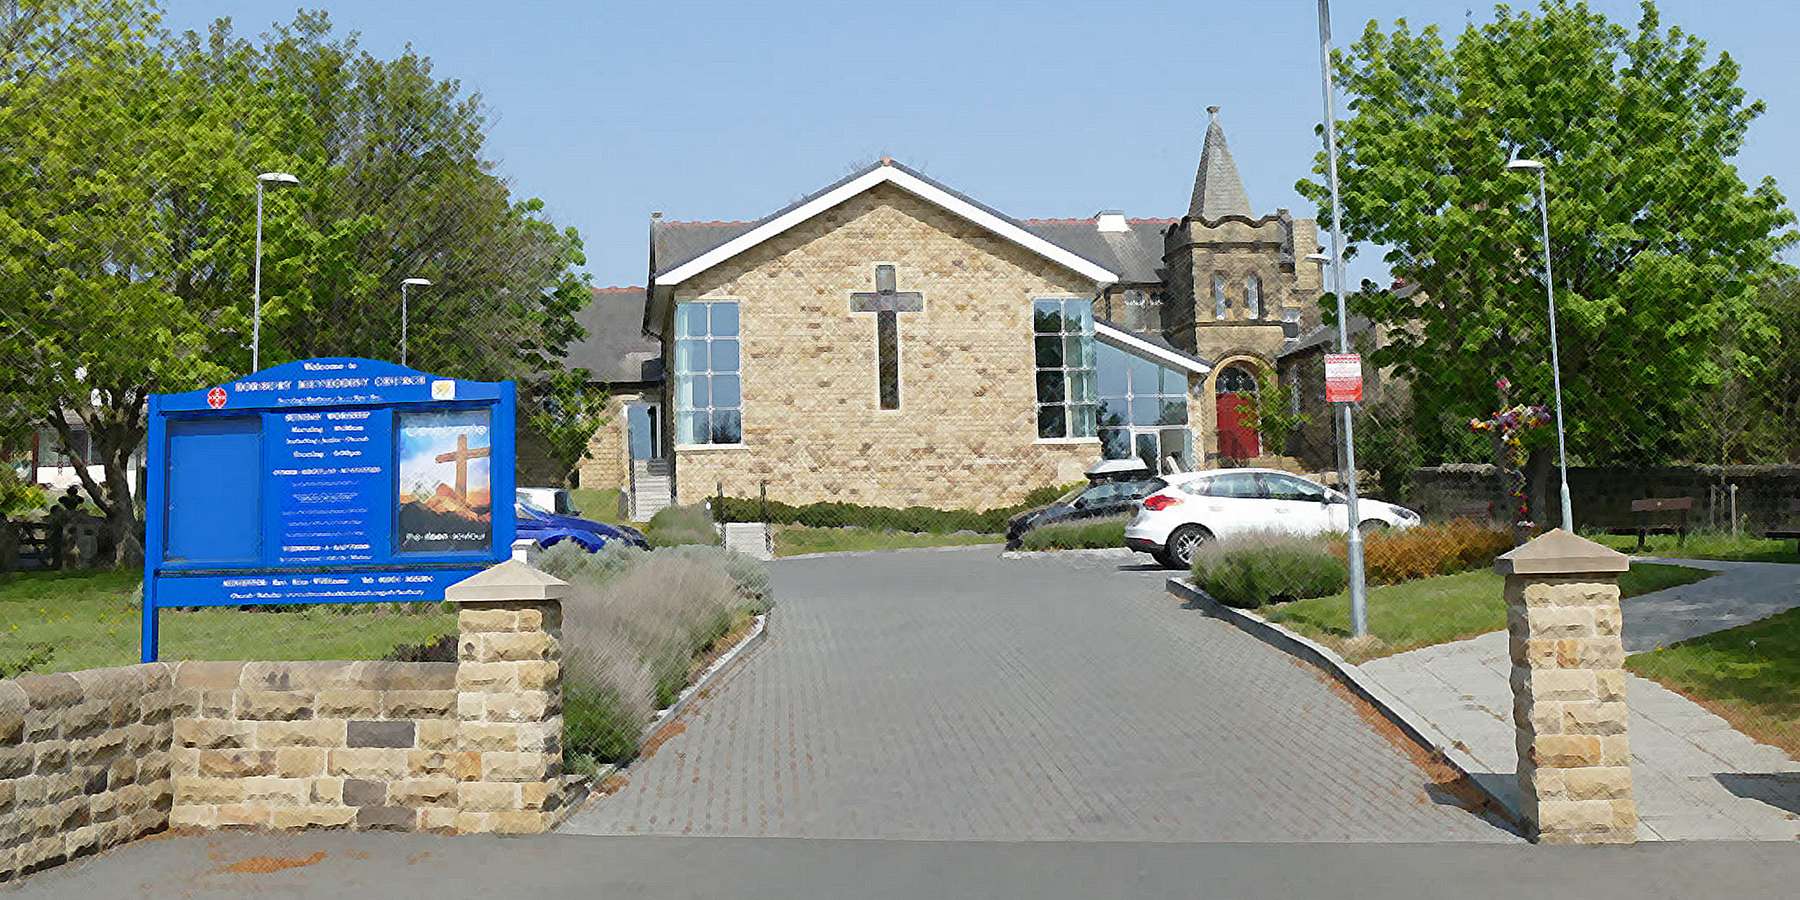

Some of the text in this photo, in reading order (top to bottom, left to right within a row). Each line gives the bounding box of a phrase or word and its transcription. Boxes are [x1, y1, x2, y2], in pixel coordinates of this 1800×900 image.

[303, 362, 344, 371] Welcome
[298, 378, 369, 389] METHODIST
[374, 376, 426, 387] CHURCH
[293, 450, 324, 458] Evening
